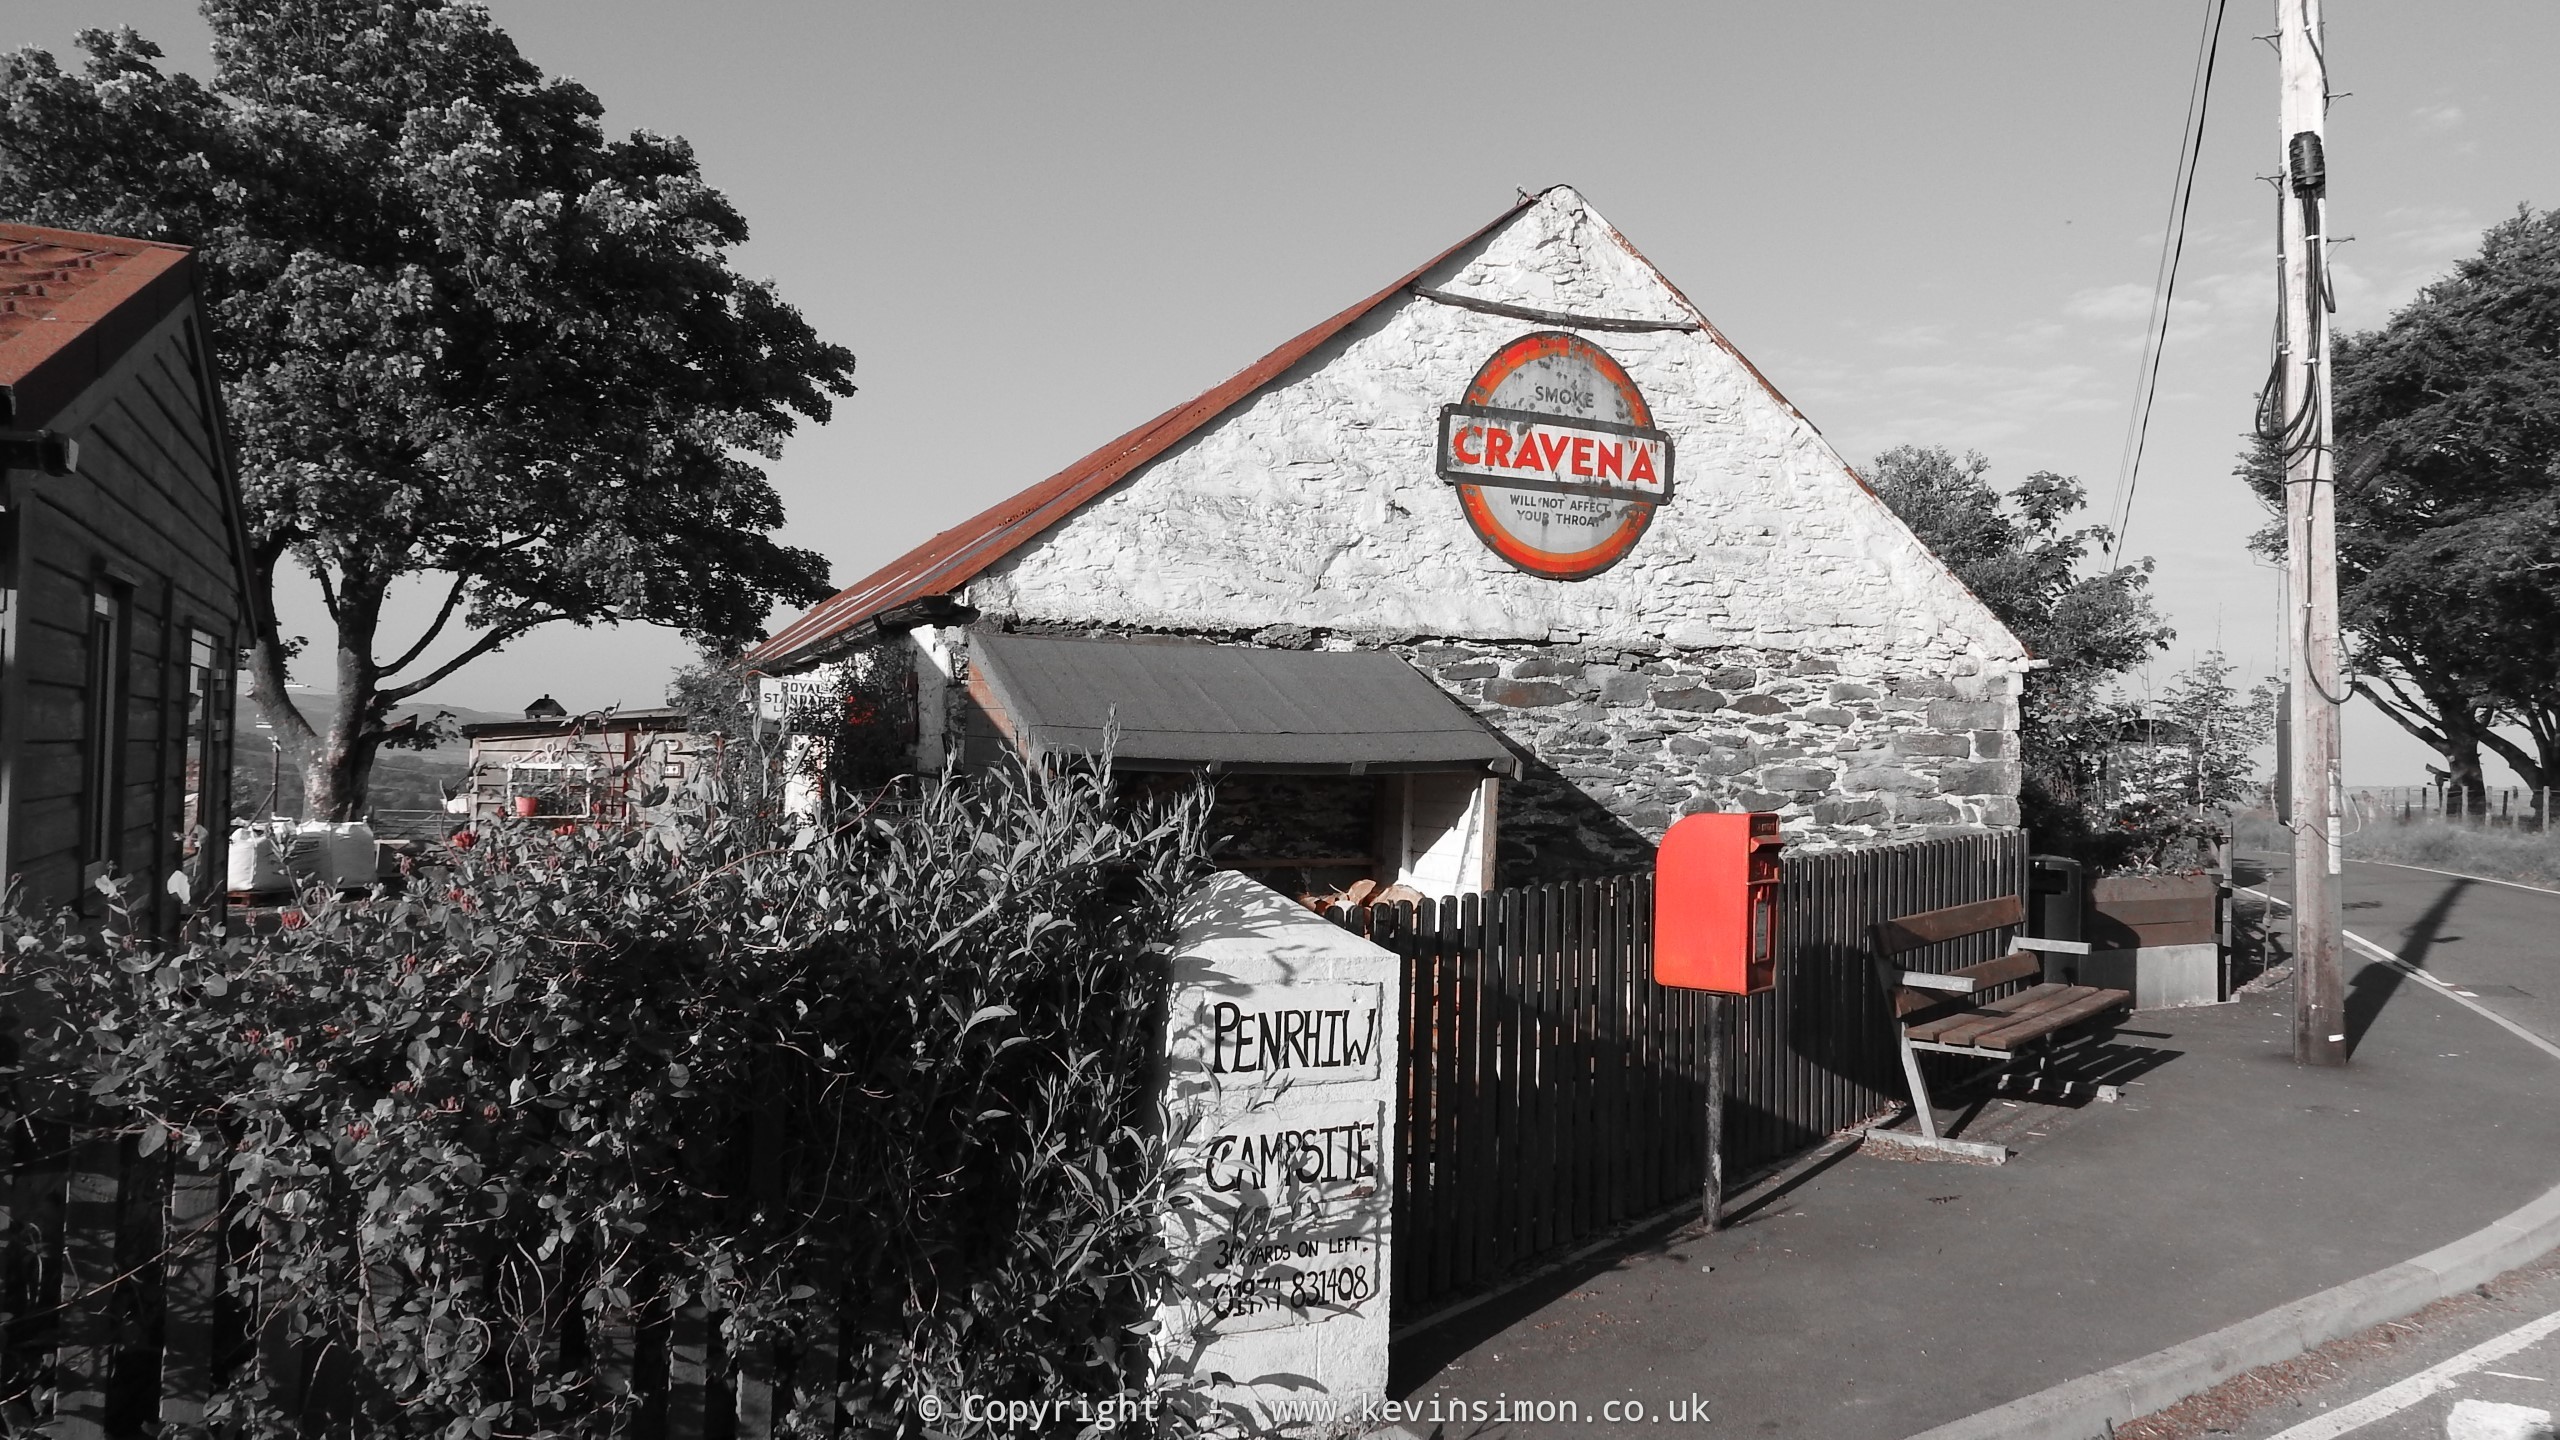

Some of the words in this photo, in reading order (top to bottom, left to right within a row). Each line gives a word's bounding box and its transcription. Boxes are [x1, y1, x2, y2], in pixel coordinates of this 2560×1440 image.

[1535, 386, 1594, 409] SMOKE
[1453, 426, 1623, 482] CRAVEN
[1509, 494, 1537, 508] WILL
[1542, 497, 1565, 510] NOT
[1569, 500, 1610, 514] AFFECT
[1516, 509, 1550, 524] YOUR
[781, 681, 823, 694] ROYAL
[1213, 1001, 1377, 1075] PENRHIW
[1206, 1121, 1376, 1193] CAMPSITE
[1248, 1243, 1291, 1266] YARDS
[1297, 1240, 1319, 1259] ON
[1290, 1265, 1369, 1310] 831408
